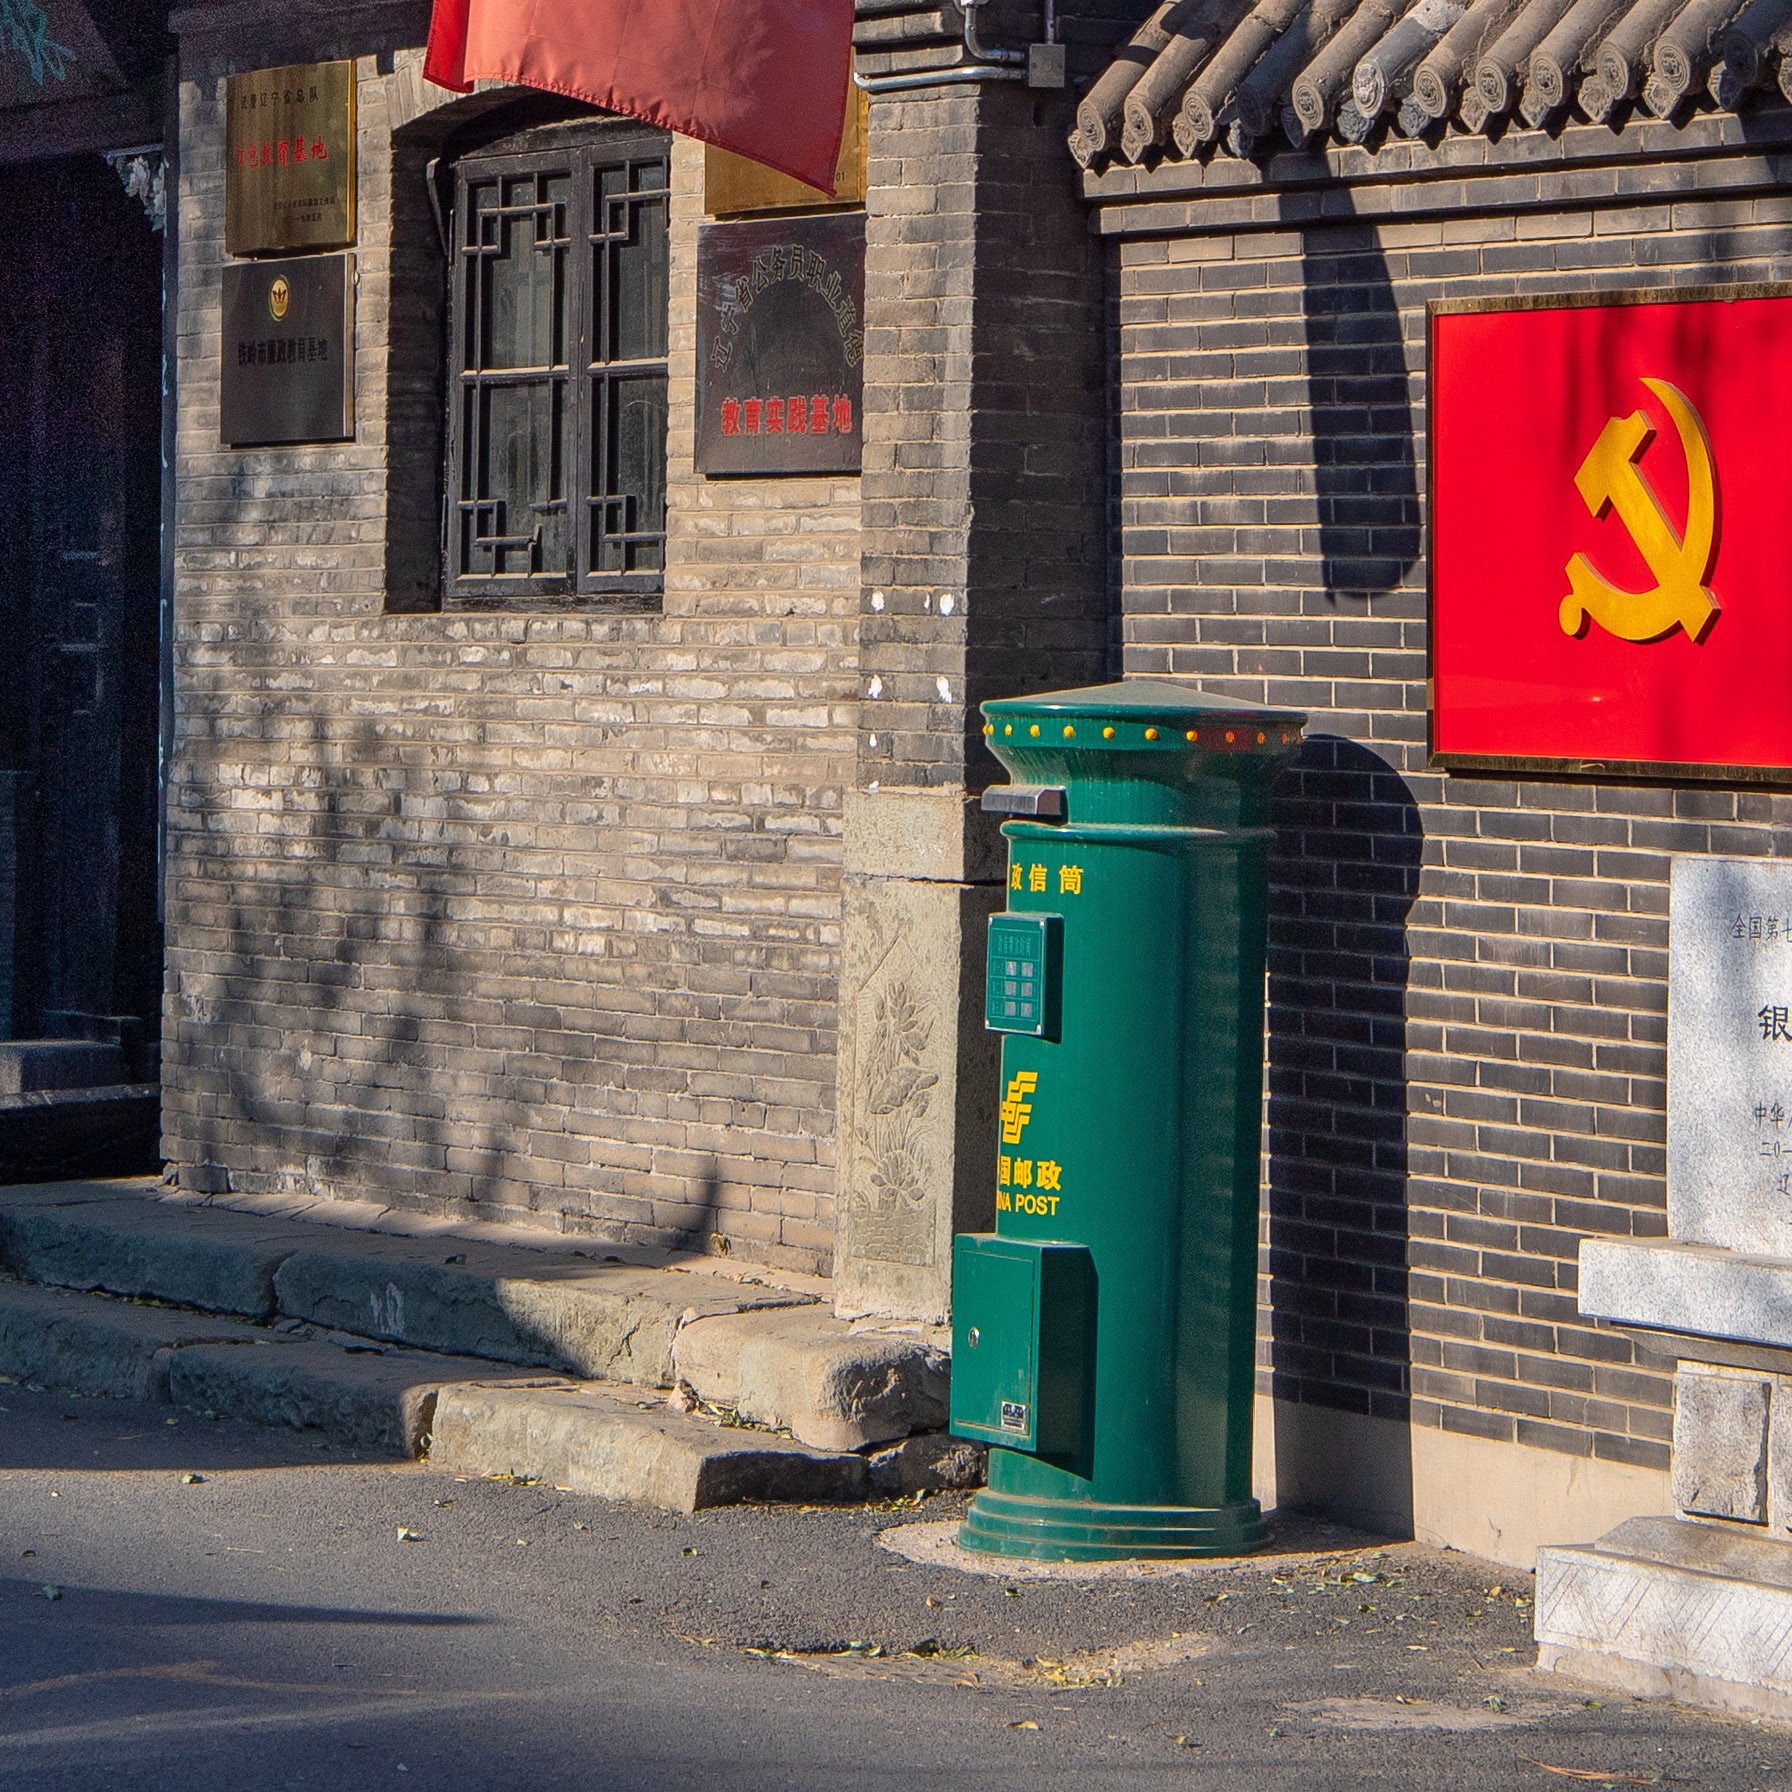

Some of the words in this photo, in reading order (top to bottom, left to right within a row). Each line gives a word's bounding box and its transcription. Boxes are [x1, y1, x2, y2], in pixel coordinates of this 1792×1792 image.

[711, 244, 864, 373] 辽宁省公务员职业道德
[721, 394, 853, 437] 教育实践基地
[1016, 1193, 1060, 1216] POST
